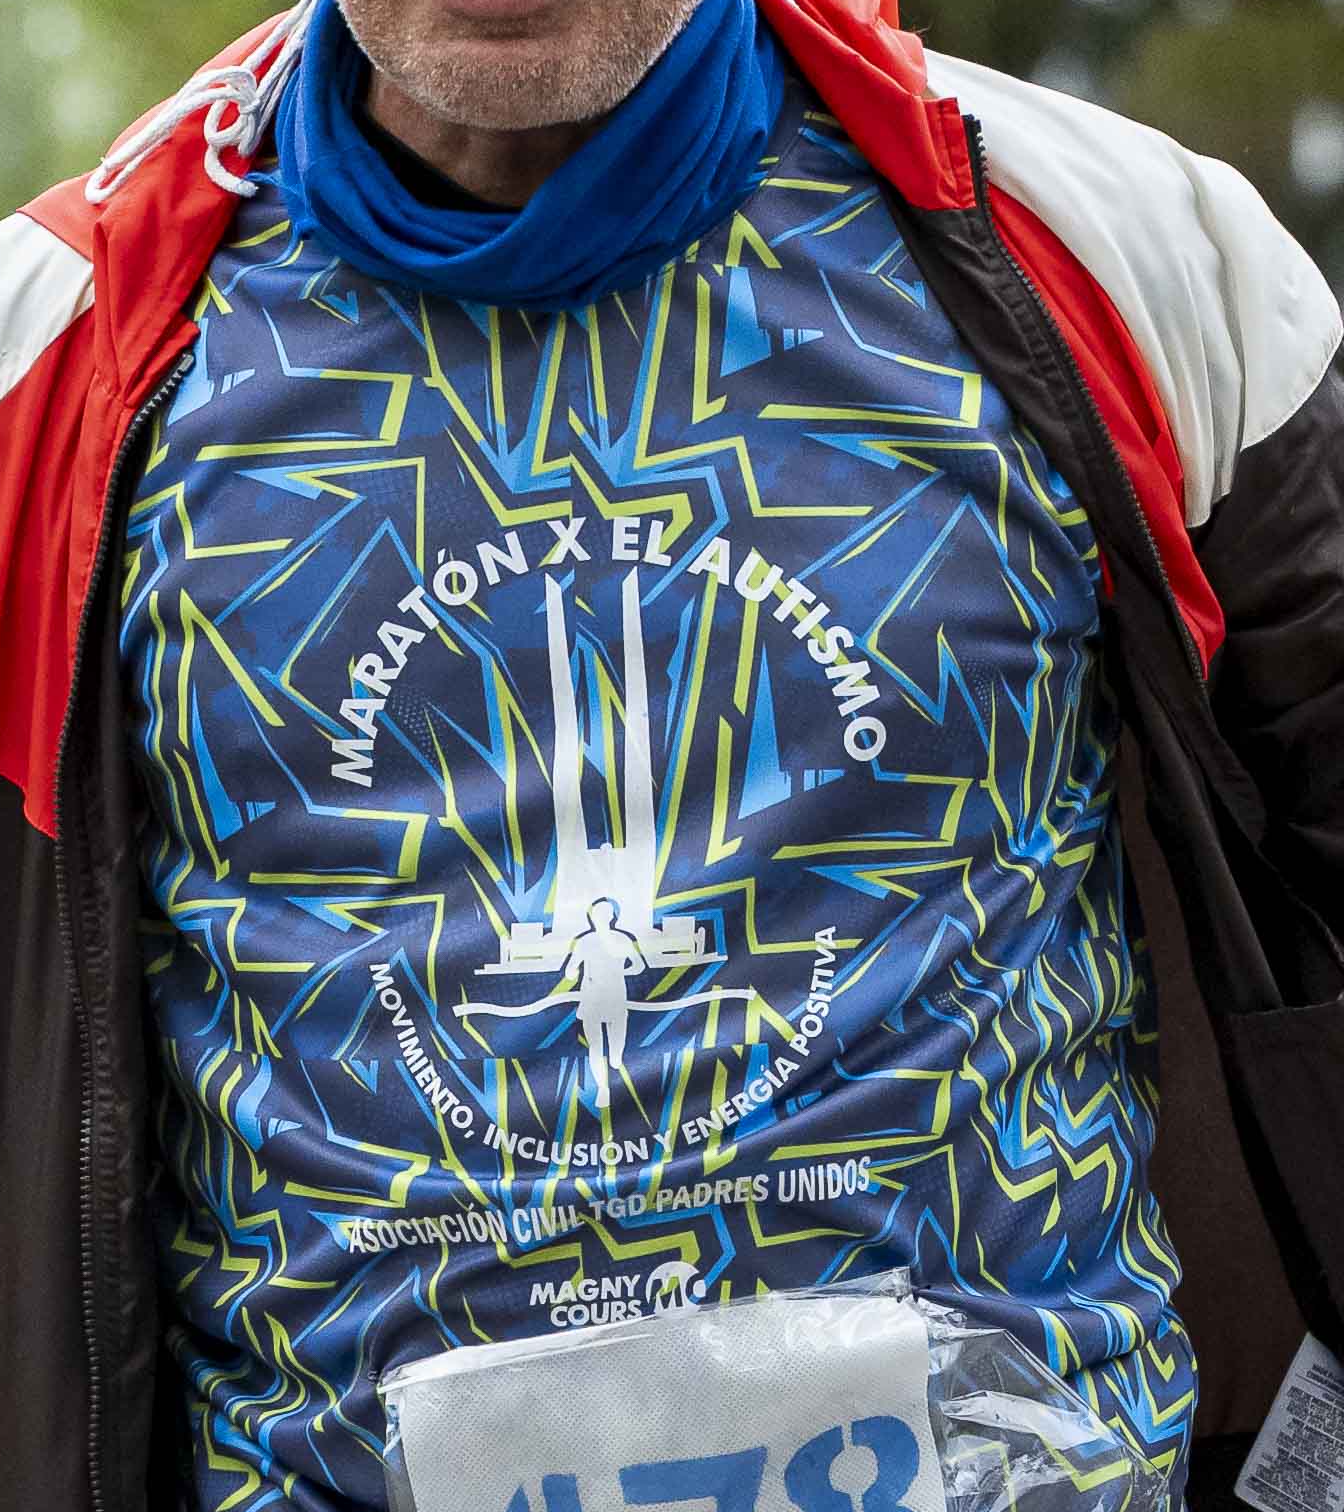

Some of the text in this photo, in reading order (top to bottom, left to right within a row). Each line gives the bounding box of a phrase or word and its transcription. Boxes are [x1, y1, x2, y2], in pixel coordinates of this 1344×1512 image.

[331, 517, 887, 787] MARATÓN X EL AUTISMO
[369, 926, 837, 1167] MOVIMIENTO, INCLUSIÓN Y ENERGÍA POSITIVA
[349, 1156, 871, 1254] ASOCIACIÓN CIVIL TGD PADRES UNIDOS
[529, 1275, 640, 1306] MAGNY
[550, 1300, 642, 1327] COURS
